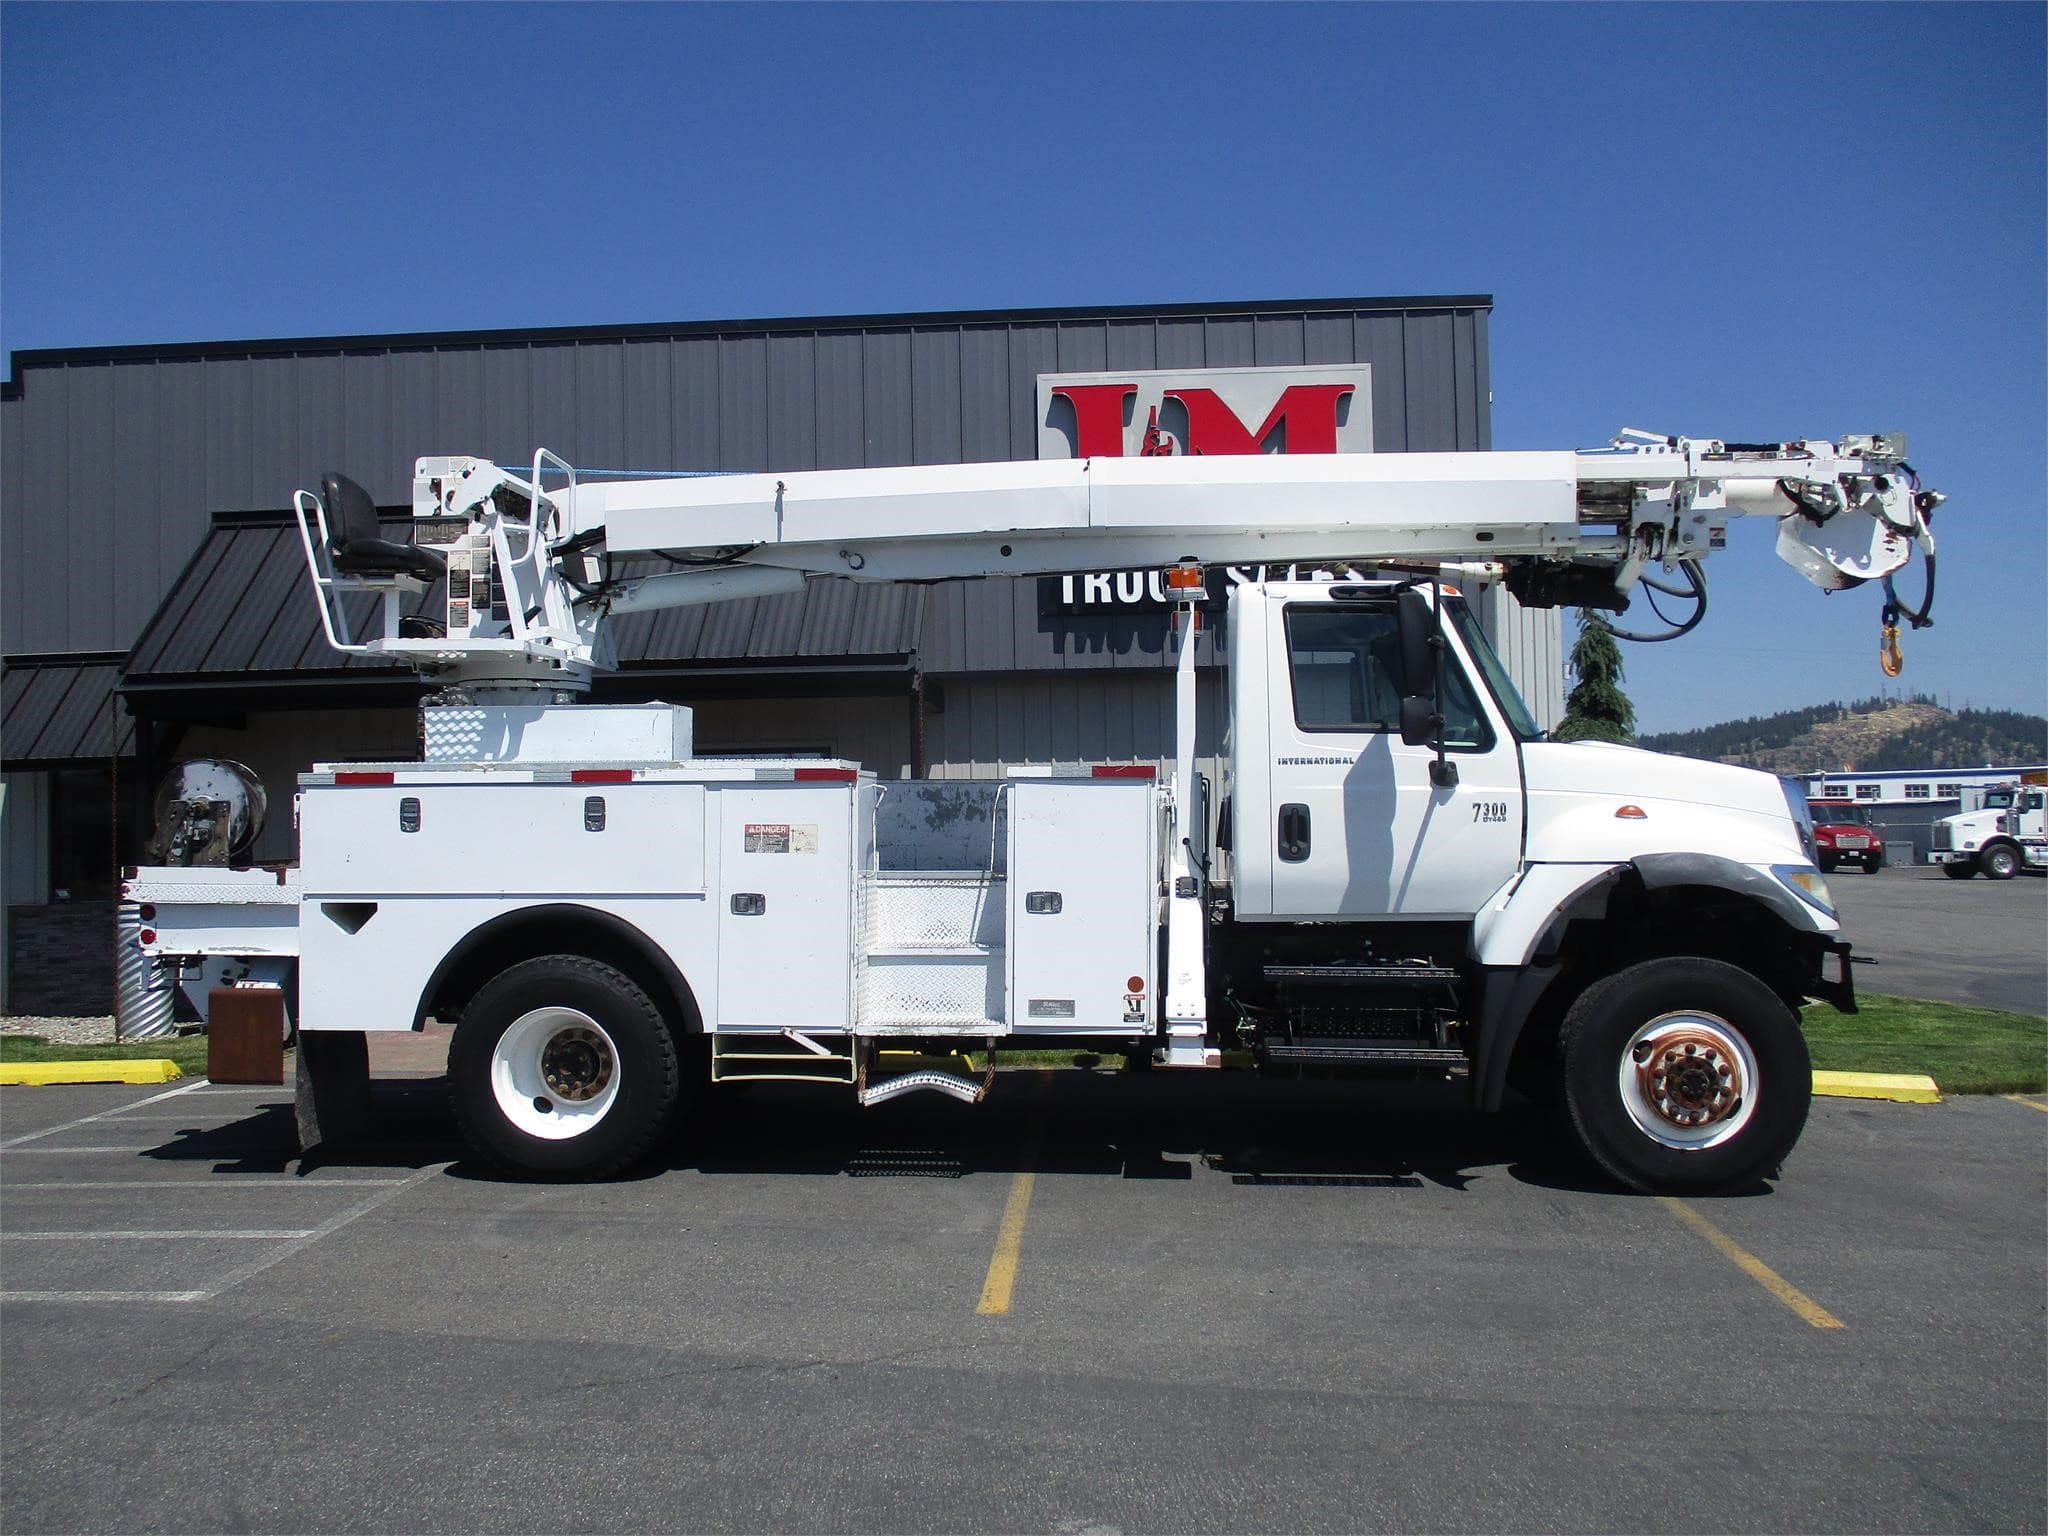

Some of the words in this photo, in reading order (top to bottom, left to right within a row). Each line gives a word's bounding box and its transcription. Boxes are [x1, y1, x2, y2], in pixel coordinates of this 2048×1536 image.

[1278, 757, 1355, 766] INTERNATIONAL
[1472, 802, 1507, 823] 7300
[755, 825, 786, 833] DANGER
